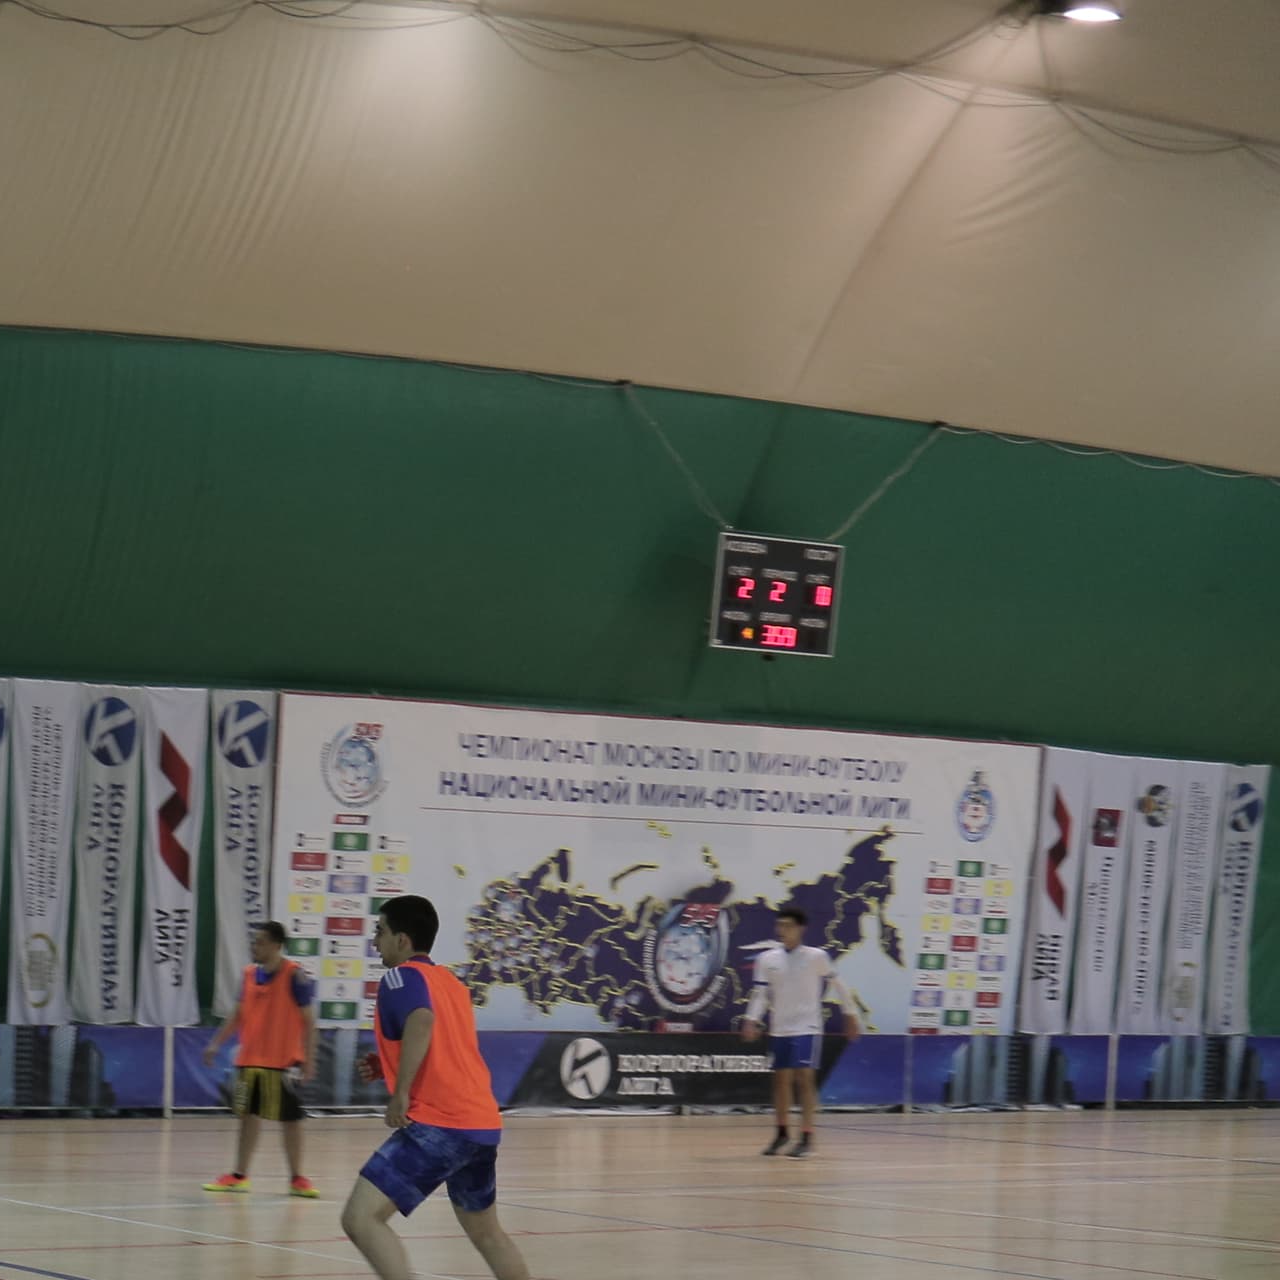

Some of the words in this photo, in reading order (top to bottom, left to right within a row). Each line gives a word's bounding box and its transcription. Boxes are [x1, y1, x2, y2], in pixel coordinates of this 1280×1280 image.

[737, 577, 755, 599] 2
[769, 581, 787, 602] 2
[458, 733, 598, 765] ЧЕМПИОНАТ
[602, 742, 704, 771] МОСКВЫ
[710, 749, 739, 773] ПО
[746, 750, 909, 783] МИНИ-ФУТБОЛУ
[439, 771, 632, 806] НАЦИОНАЛЬНОЙ
[639, 782, 855, 818] МИНИ-ФУТБОЛЬНОЙ
[858, 795, 913, 820] ЛИГИ
[101, 783, 127, 1011] КОРПОРАТИВНАЯ
